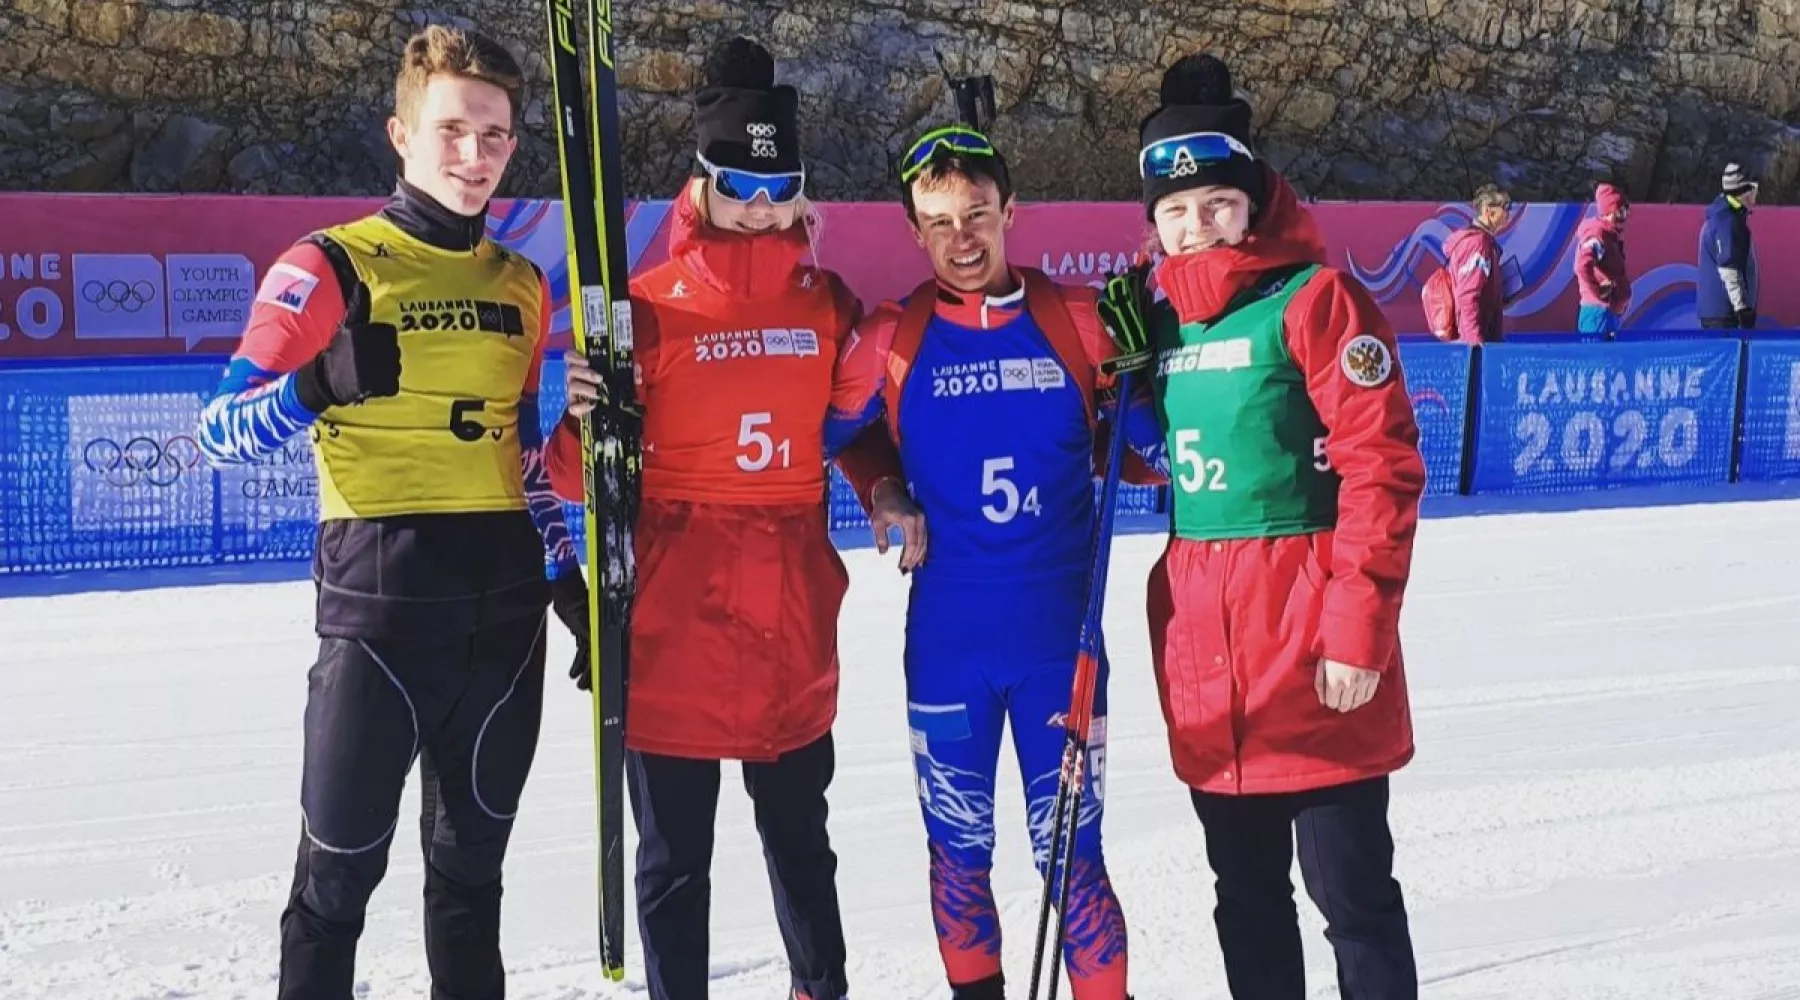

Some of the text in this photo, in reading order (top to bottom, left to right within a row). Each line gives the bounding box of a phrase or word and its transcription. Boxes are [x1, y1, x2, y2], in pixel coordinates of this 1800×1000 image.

[0, 253, 61, 281] NE
[180, 266, 240, 282] YOUTH
[173, 287, 249, 302] OLYMPIC
[399, 299, 474, 313] LAUSANNE
[181, 307, 243, 324] GAMES
[694, 328, 760, 345] LAUSANNE
[932, 359, 997, 378] LAUSANNE
[1517, 366, 1705, 406] LAUSANNE
